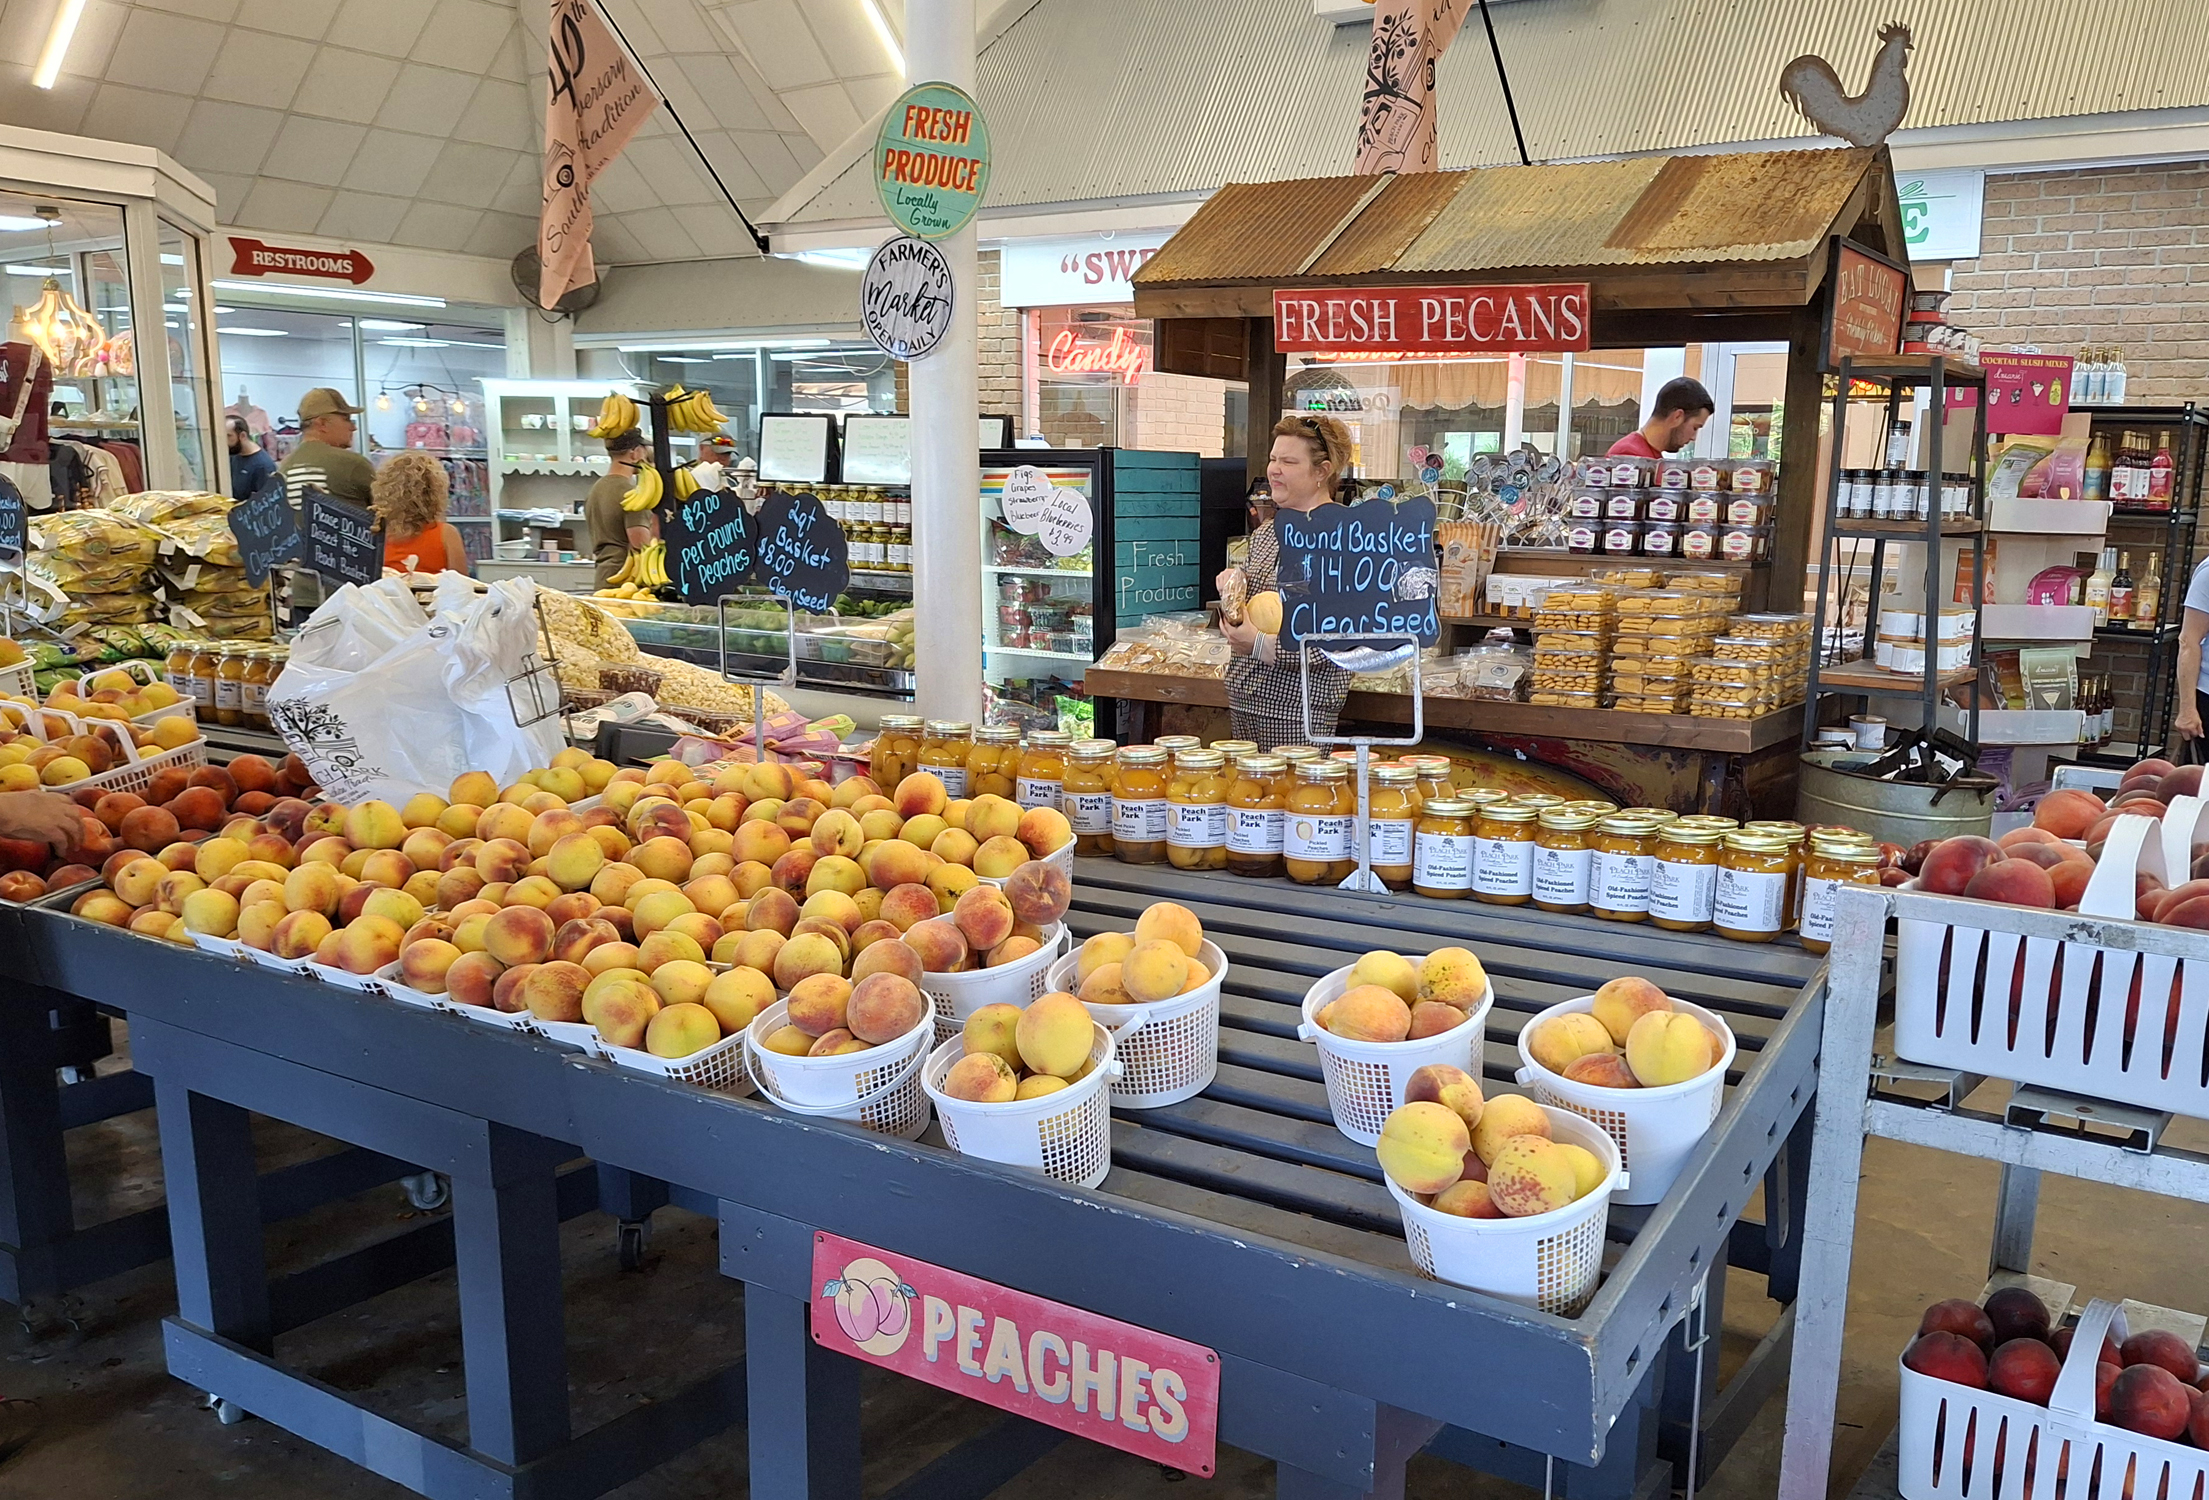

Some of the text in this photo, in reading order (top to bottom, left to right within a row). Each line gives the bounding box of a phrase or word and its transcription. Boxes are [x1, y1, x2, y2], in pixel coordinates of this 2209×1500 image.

[903, 105, 972, 146] FRESH
[883, 148, 983, 194] PRODUCE
[897, 187, 938, 214] Locally
[910, 208, 951, 230] Grown
[252, 251, 354, 273] RESTROOMS
[879, 243, 948, 289] FARMER'S
[868, 280, 949, 325] Market
[1840, 265, 1900, 322] EAT LOCAL
[868, 310, 936, 353] OPEN DAILY
[1279, 294, 1582, 342] FRESH PECANS
[1049, 327, 1142, 384] Candy
[1982, 356, 2069, 368] COCKTAIL SLUSH MIXES
[1011, 483, 1037, 493] Grapes
[1014, 470, 1033, 484] Figs
[682, 495, 720, 533] $3.00
[1051, 490, 1078, 515] Local
[313, 503, 339, 529] Please
[341, 517, 355, 536] DO
[1039, 508, 1085, 533] Blueberries
[342, 539, 359, 557] the
[775, 525, 831, 570] Basket
[1284, 520, 1431, 555] Round Basket
[757, 536, 795, 576] $8.00
[1132, 540, 1184, 573] Fresh
[1121, 575, 1194, 609] Produce
[1030, 783, 1053, 791] Peach
[1121, 804, 1144, 812] Peach
[1121, 811, 1140, 819] Park
[1240, 812, 1265, 820] Peach
[1318, 819, 1343, 827] Peach
[1240, 820, 1261, 828] Park
[1318, 827, 1339, 835] Park
[923, 1294, 1189, 1443] PEACHES
